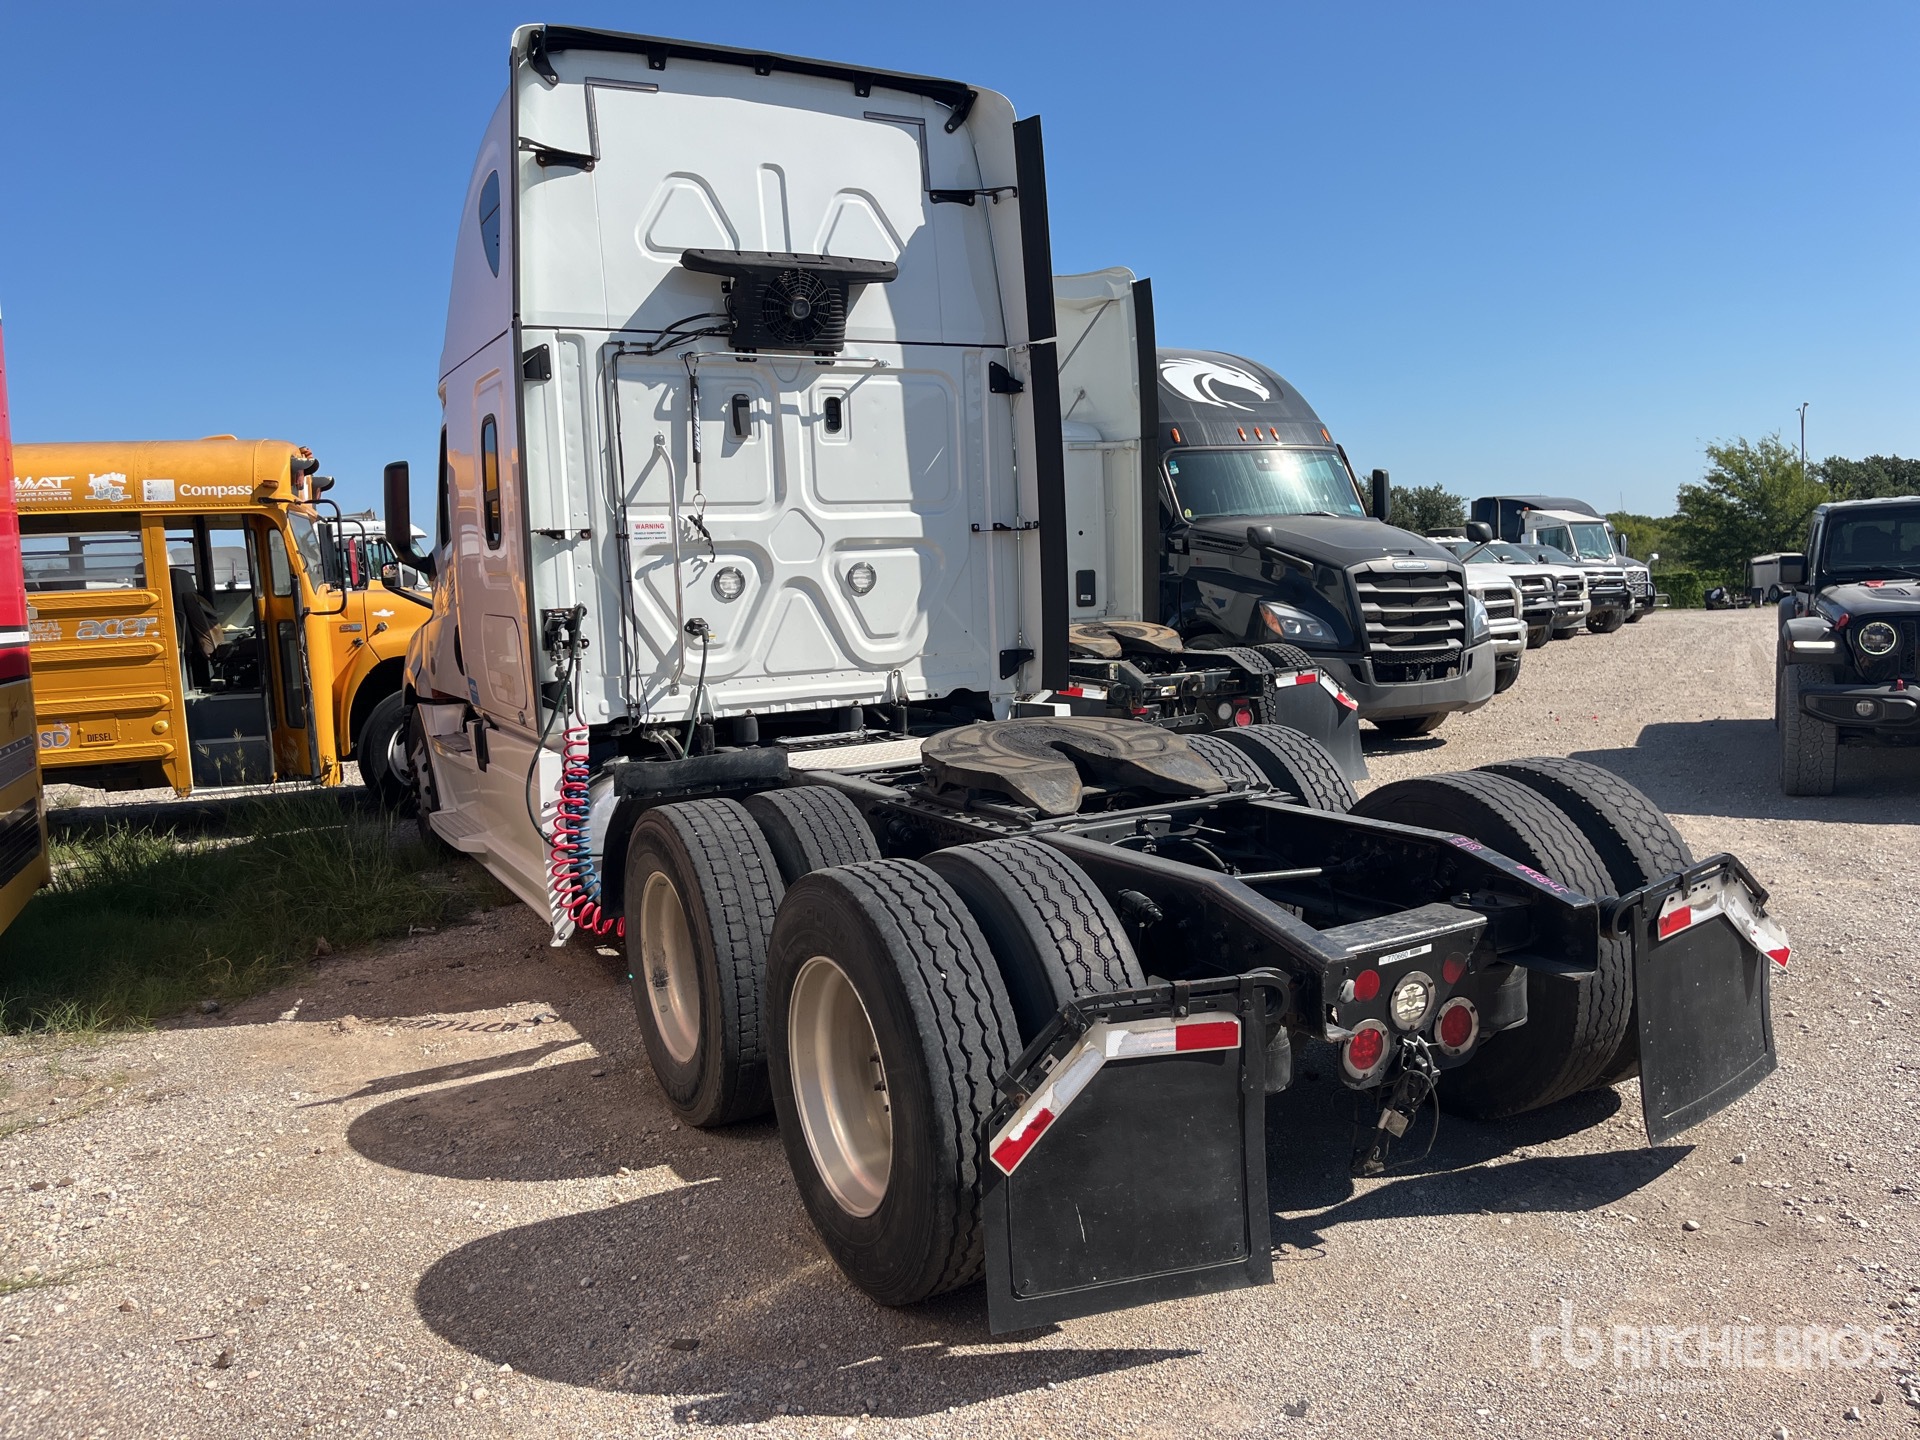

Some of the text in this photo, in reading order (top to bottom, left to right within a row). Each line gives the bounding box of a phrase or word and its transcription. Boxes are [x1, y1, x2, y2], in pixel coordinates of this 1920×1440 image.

[179, 483, 253, 498] Compass
[634, 522, 665, 530] WARNING
[86, 732, 113, 742] DIESEL
